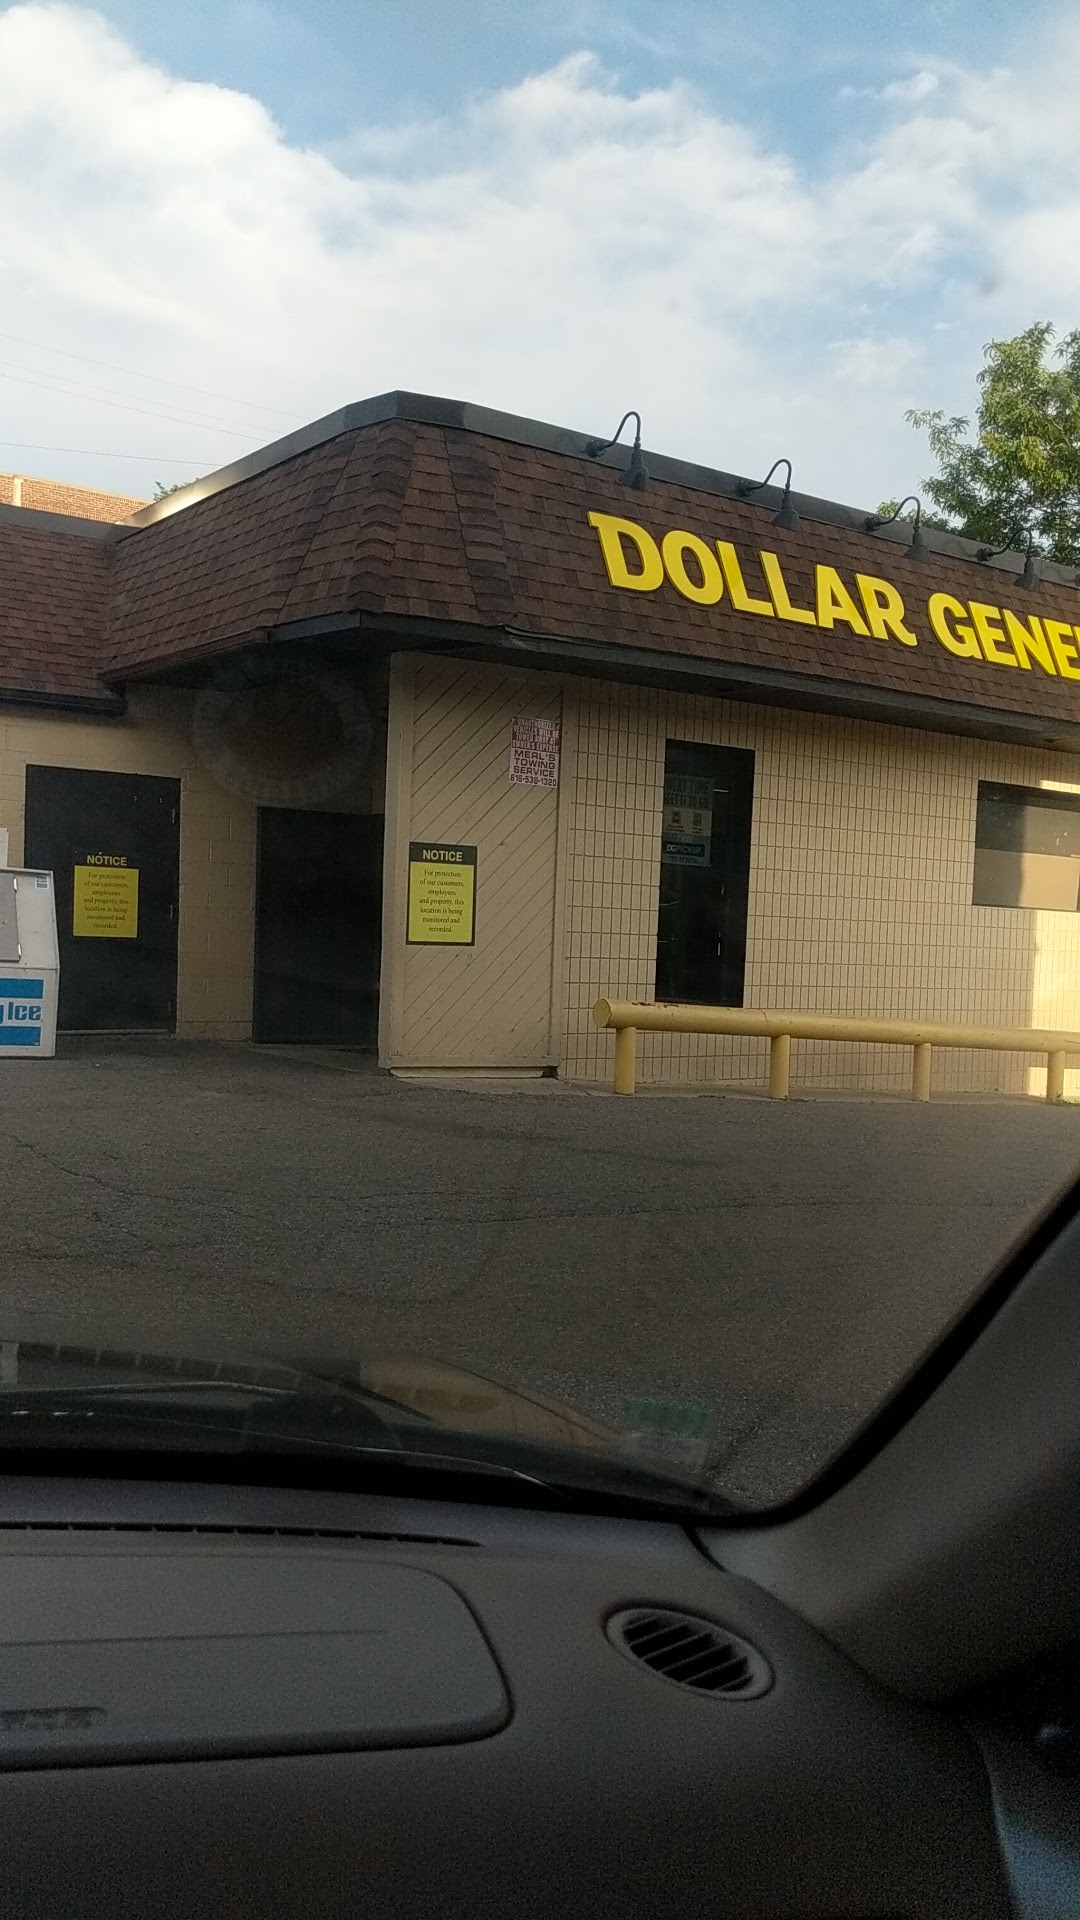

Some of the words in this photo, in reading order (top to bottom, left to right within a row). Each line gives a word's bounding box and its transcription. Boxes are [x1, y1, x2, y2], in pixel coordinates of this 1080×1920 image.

[586, 511, 918, 647] DOLLAR
[516, 732, 534, 743] TOWED
[535, 735, 548, 744] AWAY
[549, 737, 556, 745] AT
[538, 728, 551, 738] WILL
[552, 730, 560, 739] BE
[537, 742, 560, 753] EXPENSE
[514, 749, 556, 762] MERL'S
[514, 757, 556, 770] TOWING
[513, 765, 555, 778] SERVICE
[86, 855, 128, 866] NOTICE
[422, 849, 464, 862] NOTICE
[437, 880, 465, 888] customers,
[430, 898, 454, 906] property,
[113, 906, 128, 914] being
[448, 908, 463, 917] being
[8, 1001, 42, 1021] Ice
